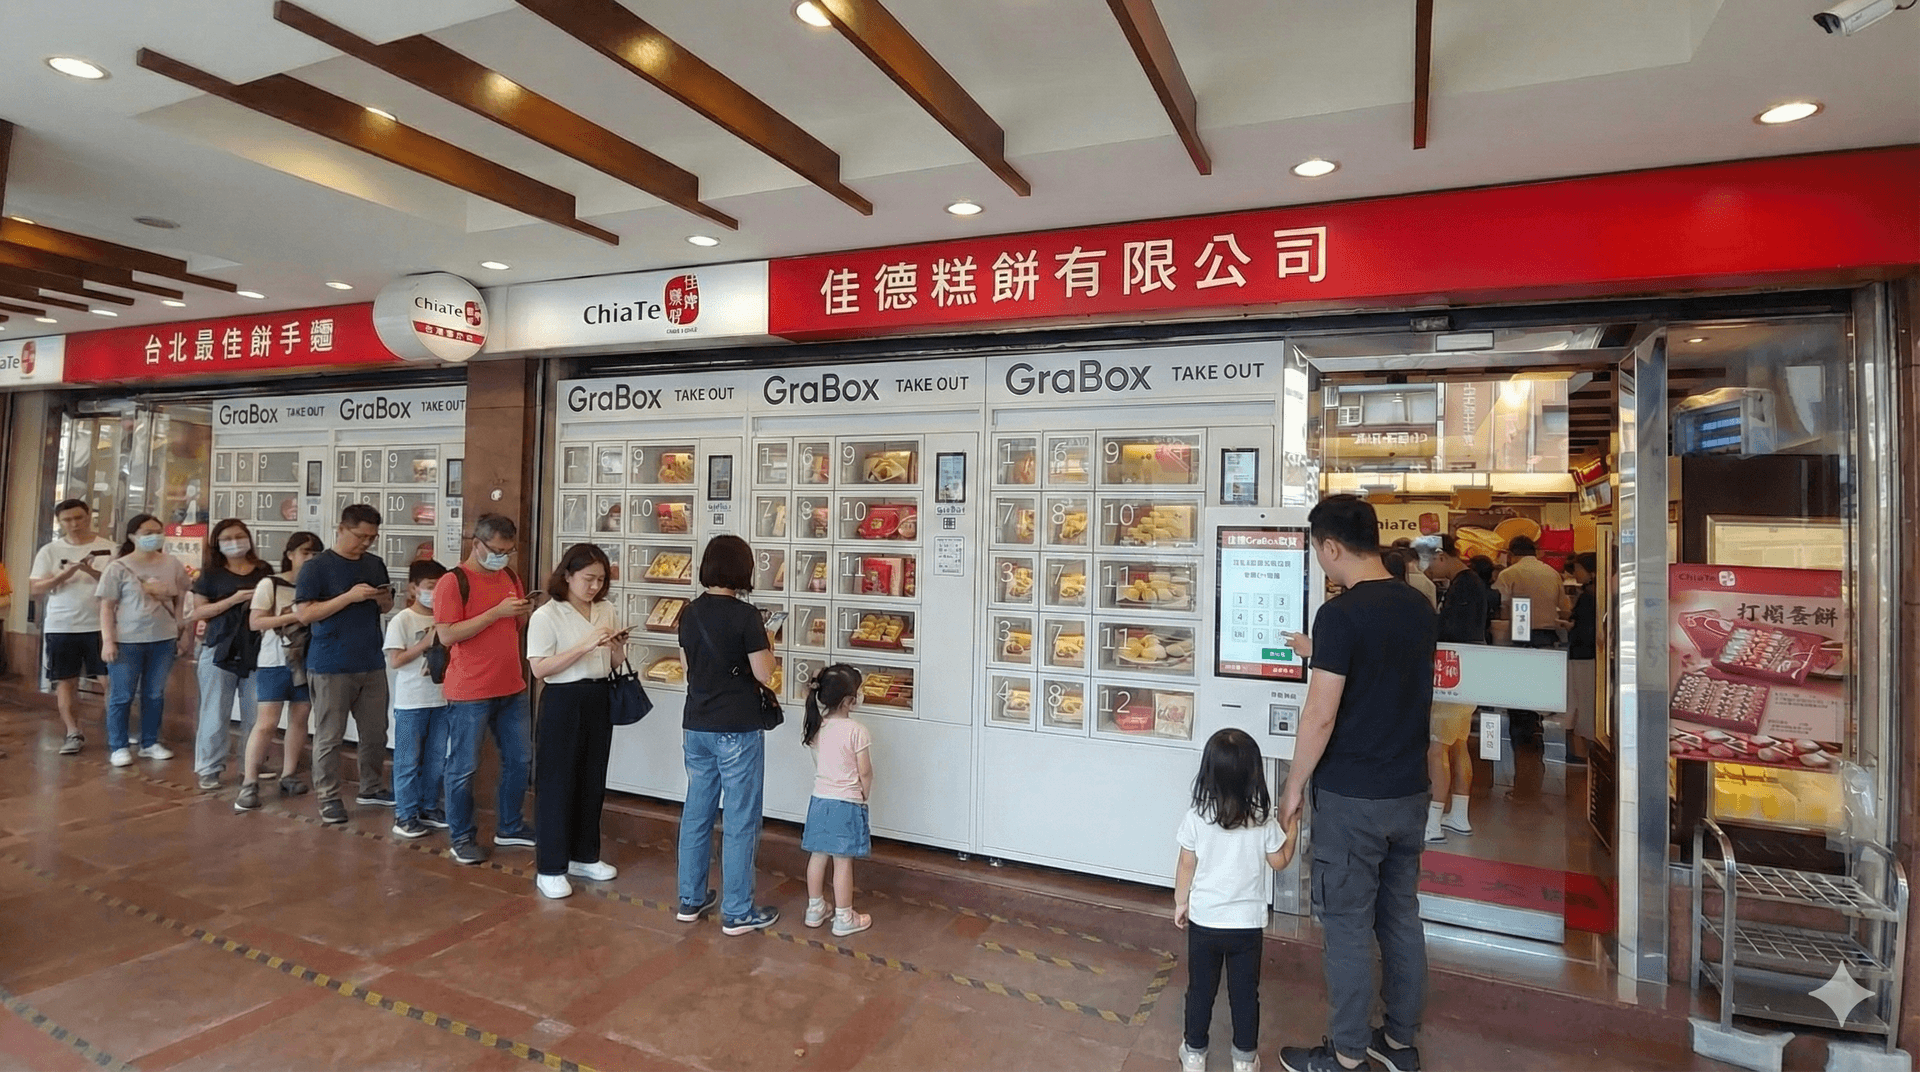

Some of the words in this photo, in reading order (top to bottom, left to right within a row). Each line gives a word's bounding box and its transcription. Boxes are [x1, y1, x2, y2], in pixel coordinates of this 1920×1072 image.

[820, 225, 1328, 316] 佳德糕餅有限公司
[415, 296, 463, 317] ChiaTe
[583, 300, 661, 325] ChiaTe
[1004, 358, 1152, 396] GraBox
[1171, 364, 1217, 382] TAKE
[1222, 363, 1264, 381] OUT
[567, 383, 662, 413] GraBox
[675, 388, 705, 402] TAKE
[708, 386, 735, 401] OUT
[763, 374, 880, 406] GraBox
[896, 378, 933, 393] TAKE
[936, 376, 969, 391] OUT
[219, 403, 279, 425] GraBox
[286, 407, 306, 417] TAKE
[307, 406, 325, 417] OUT
[339, 396, 412, 421] GraBox
[421, 401, 444, 412] TAKE
[445, 399, 466, 411] OUT
[217, 454, 226, 469] 1
[259, 454, 268, 469] 9
[339, 453, 349, 469] 1
[363, 453, 373, 469] 6
[388, 452, 399, 469] 9
[567, 450, 578, 469] 1
[633, 449, 644, 468] 9
[761, 447, 773, 467] 1
[802, 446, 814, 466] 6
[842, 445, 856, 466] 9
[1001, 442, 1015, 465] 1
[1054, 441, 1067, 462] 6
[1104, 441, 1120, 464] 9
[216, 493, 224, 508] 7
[237, 493, 245, 508] 8
[258, 493, 273, 509] 10
[338, 494, 348, 510] 7
[387, 495, 405, 512] 10
[566, 498, 578, 518] 7
[631, 499, 653, 517] 10
[801, 501, 812, 520] 8
[842, 501, 867, 521] 10
[999, 502, 1015, 525] 7
[1051, 503, 1066, 524] 8
[1103, 503, 1134, 526] 10
[256, 533, 271, 548] 11
[386, 537, 404, 554] 11
[759, 552, 770, 571] 3
[801, 554, 813, 574] 7
[840, 555, 866, 577] 11
[1000, 561, 1014, 583] 3
[1051, 563, 1065, 585] 7
[1103, 565, 1134, 588] 11
[799, 608, 811, 628] 7
[839, 611, 863, 631] 11
[998, 620, 1011, 642] 3
[1051, 624, 1063, 645] 7
[1101, 627, 1132, 650] 11
[796, 662, 809, 683] 8
[1048, 684, 1063, 707] 8
[1099, 689, 1131, 713] 12
